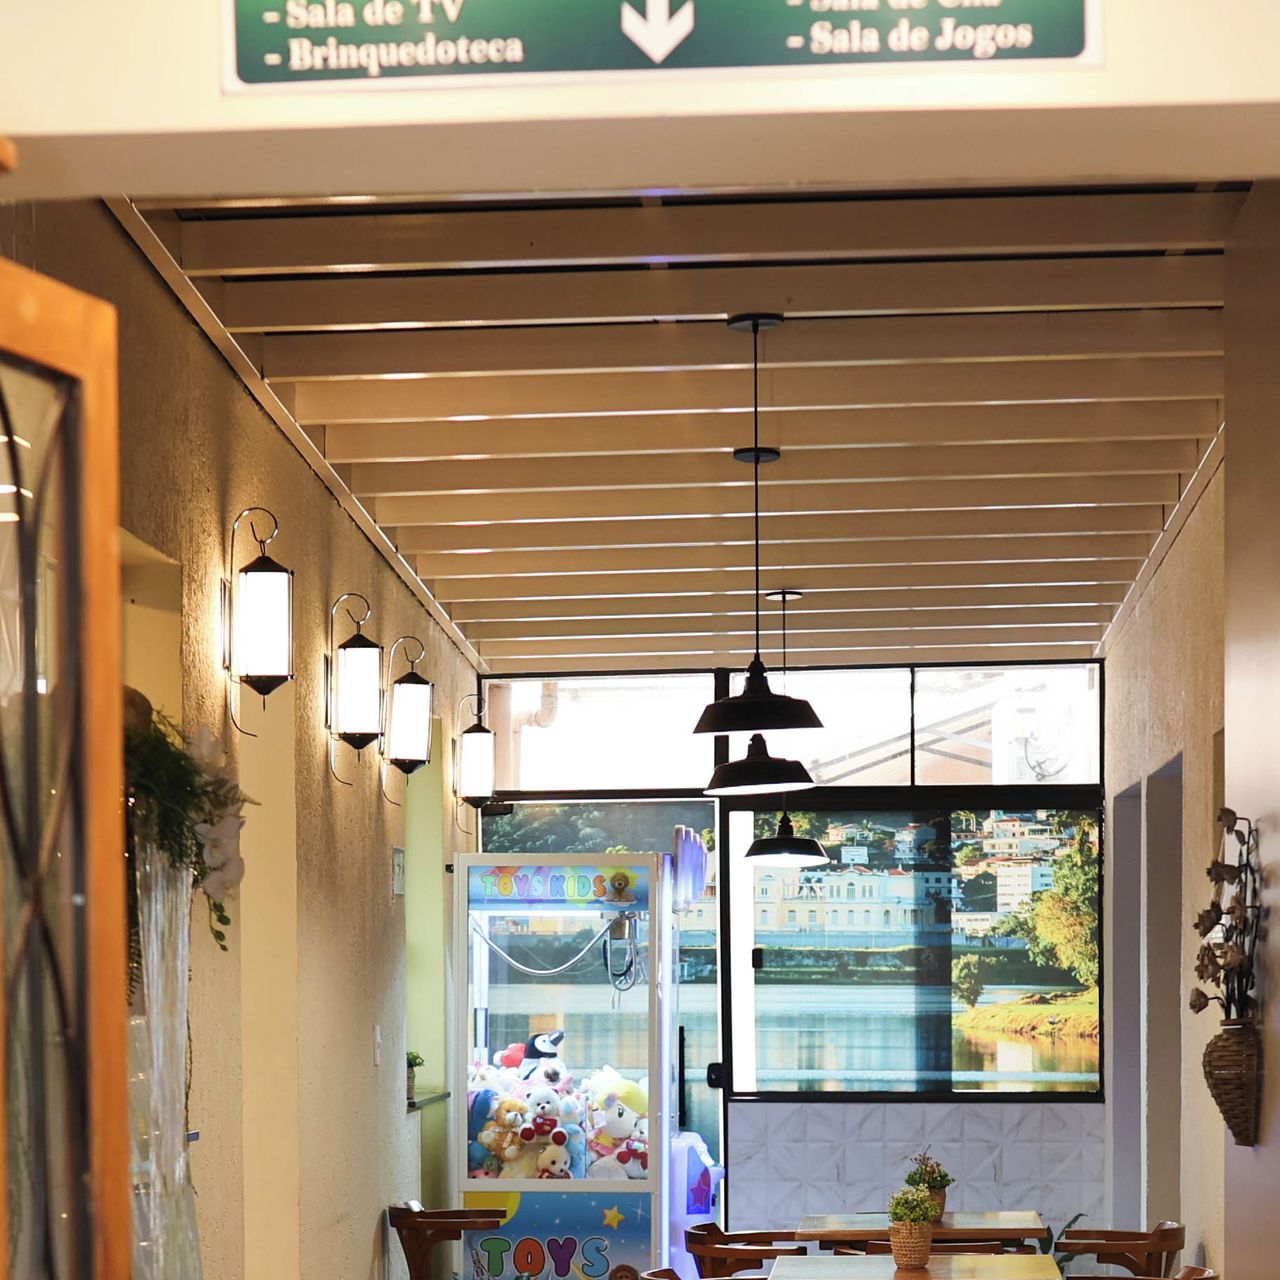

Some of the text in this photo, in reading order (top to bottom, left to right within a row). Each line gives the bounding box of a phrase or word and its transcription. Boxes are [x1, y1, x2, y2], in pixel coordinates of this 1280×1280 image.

[286, 0, 356, 29] Sala
[362, 0, 405, 26] de
[287, 31, 525, 77] Brinquedoteca
[809, 20, 881, 54] Sala
[887, 17, 930, 51] de
[934, 17, 1034, 59] Jogos
[480, 874, 608, 898] TOYS KIDS
[479, 1236, 611, 1279] TOYS
